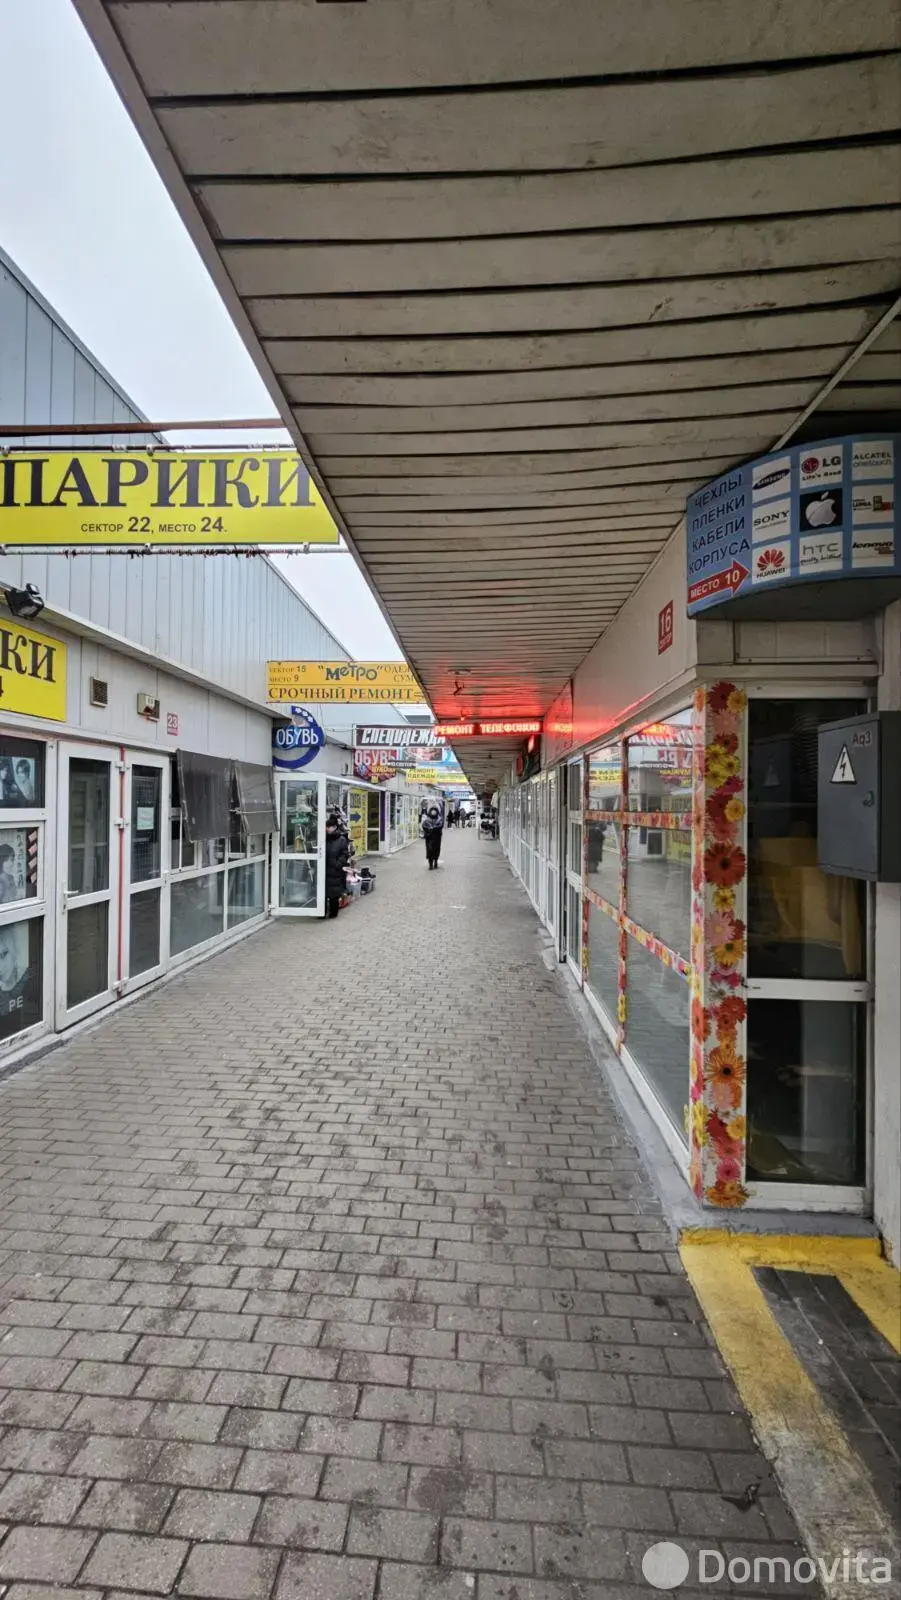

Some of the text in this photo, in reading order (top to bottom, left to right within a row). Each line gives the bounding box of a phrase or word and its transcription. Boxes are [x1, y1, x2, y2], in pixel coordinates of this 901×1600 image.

[822, 455, 842, 468] LG
[853, 452, 892, 460] ALCATEL
[0, 457, 316, 508] ПАРИКИ
[694, 473, 743, 509] ЧЕХЛЫ
[692, 494, 746, 532] ПЛЕНКИ
[753, 510, 789, 526] SONY
[81, 516, 228, 534] СЕКТОР 22, МЕСТО 24.
[692, 516, 746, 553] КАБЕЛИ
[688, 537, 750, 575] КОРПУСА
[690, 569, 740, 599] МЕСТО 10
[661, 607, 671, 636] 16
[294, 674, 299, 682] 9
[268, 687, 413, 699] СРОЧНЫЙ РЕМОНТ
[168, 715, 177, 729] 23
[434, 723, 474, 735] РЕМОНТ
[276, 728, 319, 745] ОБУВЬ
[354, 749, 396, 766] ОБУВЬ
